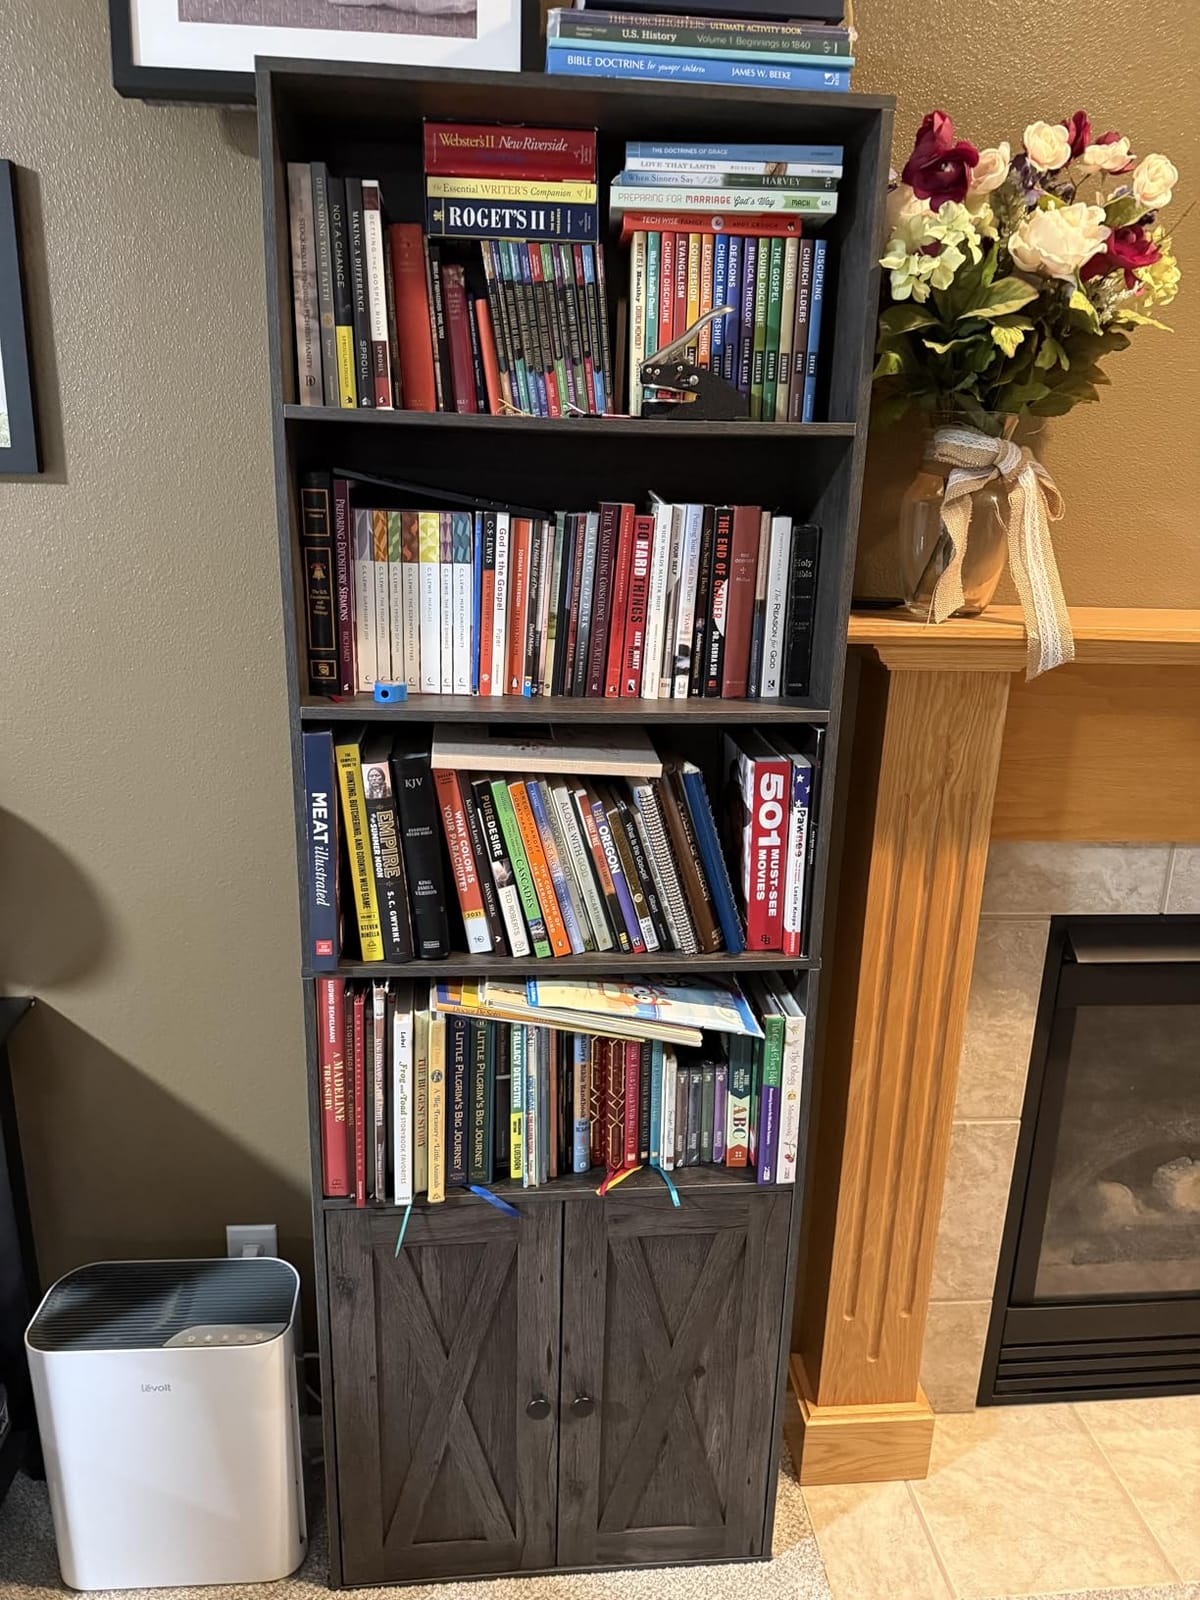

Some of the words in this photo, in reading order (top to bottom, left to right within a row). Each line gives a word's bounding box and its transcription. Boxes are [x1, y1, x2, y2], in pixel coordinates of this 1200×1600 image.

[622, 29, 639, 39] U.S.
[642, 30, 677, 42] History
[697, 35, 727, 45] Volume
[736, 37, 780, 50] Beginnings
[791, 40, 811, 50] 1840
[710, 22, 746, 32] ULTIMATE
[748, 24, 780, 34] ACTIVITY
[567, 55, 592, 67] BIBLE
[595, 57, 645, 71] DOCTRINE
[731, 67, 755, 78] JAMES
[769, 71, 792, 81] BEEKE
[439, 132, 485, 148] Webster's
[499, 136, 523, 149] New
[523, 137, 568, 152] Riverside
[443, 183, 479, 194] Essential
[479, 184, 529, 196] WRITER'S
[530, 187, 572, 199] Companion
[652, 175, 679, 184] Sinners
[762, 176, 801, 187] HARVEY
[332, 203, 341, 228] NOT
[618, 193, 664, 203] PREPARING
[685, 195, 732, 206] MARRIAGE
[733, 195, 756, 208] God's
[791, 199, 811, 207] MACK
[351, 210, 361, 246] MAKING
[368, 213, 378, 252] GETTING
[448, 206, 527, 230] ROGET'S
[319, 240, 329, 267] YOUR
[335, 240, 346, 289] CHANCE
[663, 241, 672, 275] CHURCH
[677, 240, 687, 298] EVANGELISM
[716, 243, 726, 282] CHURCH
[728, 244, 737, 288] DEACONS
[747, 246, 756, 284] BIBLICAL
[759, 247, 768, 279] SOUND
[773, 247, 781, 265] THE
[786, 246, 796, 291] MISSIONS
[801, 247, 811, 285] CHURCH
[354, 258, 365, 313] DIFFERENCE
[371, 272, 380, 304] GOSPEL
[689, 242, 699, 301] CONVERSION
[702, 244, 711, 305] EXPOSITIONAL
[771, 267, 780, 303] GOSPEL
[814, 249, 825, 300] DISCIPLING
[662, 278, 672, 323] DISCIPLINE
[744, 286, 753, 328] THEOLOGY
[757, 282, 766, 327] DOCTRINE
[798, 289, 808, 323] ELDERS
[359, 340, 369, 380] SPROUL
[376, 344, 384, 373] SPROUL
[808, 354, 816, 374] DEVER
[335, 498, 346, 539] PREPARING
[604, 511, 614, 526] THE
[717, 516, 730, 534] THE
[485, 537, 493, 564] LEWIS
[498, 528, 507, 548] God
[585, 526, 596, 573] WALKING
[600, 528, 613, 574] VANISHING
[671, 542, 679, 559] YOUR
[716, 537, 728, 559] END
[337, 541, 348, 585] EXPOSITORY
[497, 561, 505, 577] the
[634, 540, 649, 577] HARD
[714, 562, 726, 577] OF
[495, 578, 505, 611] Gospel
[657, 568, 665, 594] MATTER
[700, 577, 708, 595] Body
[339, 586, 349, 621] SERMONS
[581, 603, 590, 629] DARK
[597, 577, 609, 622] CONSCIENCE
[631, 576, 646, 623] THINGS
[711, 580, 726, 620] GENDER
[770, 603, 782, 638] REASON
[342, 630, 351, 662] RICHARD
[495, 628, 503, 647] Piper
[695, 631, 703, 652] Andrew
[710, 643, 719, 663] DEBRA
[768, 650, 778, 669] GOD
[404, 777, 424, 789] KJV
[310, 792, 329, 844] MEAT
[443, 804, 455, 832] YOUR
[453, 810, 466, 836] WHAT
[513, 792, 528, 832] JONATHAN
[524, 833, 535, 855] HAIDT
[757, 772, 784, 847] 501
[345, 770, 357, 799] HUNTING,
[355, 851, 367, 877] COOKING
[361, 892, 371, 909] GAME
[369, 823, 381, 855] SUMMER
[376, 809, 401, 879] EMPIRE
[525, 813, 541, 854] LUKIANOFF
[550, 816, 563, 847] GARDEN
[564, 865, 573, 883] CITY
[560, 801, 576, 831] ALONE
[569, 832, 582, 858] WITH
[577, 858, 590, 878] GOD
[599, 825, 621, 875] OREGON
[794, 809, 807, 858] Pawnee
[374, 856, 384, 878] MOON
[448, 834, 468, 893] PARACHUTE?
[458, 836, 473, 873] COLOR
[314, 844, 330, 906] illustrated
[515, 858, 534, 909] CASCADES
[539, 863, 549, 879] THE
[544, 880, 558, 917] CODDLING
[694, 859, 710, 901] OREGON
[756, 848, 767, 901] MOVIES
[768, 848, 781, 917] MUST-SEE
[483, 882, 493, 904] DANNY
[536, 878, 551, 915] AMERICAN
[547, 916, 557, 934] MIND
[648, 894, 659, 913] Gilbert
[792, 886, 800, 906] Leslie
[389, 910, 401, 943] GWYNNE
[487, 903, 496, 918] SILK
[507, 904, 520, 937] ROBERTS
[790, 907, 799, 927] Knope
[327, 980, 336, 1004] LUDWIG
[328, 1005, 337, 1043] BEMELMANS
[454, 1031, 465, 1062] LITTLE
[476, 1030, 486, 1060] LITTLE
[512, 1030, 523, 1065] FALLACY
[399, 1060, 408, 1084] Frog
[417, 1058, 427, 1078] THE
[786, 1064, 799, 1087] Ology
[323, 1063, 333, 1110] TREASURY
[333, 1060, 345, 1122] MADELINE
[416, 1078, 426, 1117] BIGGEST
[454, 1063, 465, 1110] PILGRIM'S
[475, 1062, 485, 1109] PILGRIM'S
[512, 1066, 522, 1109] DETECTIVE
[399, 1094, 408, 1116] Toad
[454, 1111, 463, 1128] BIG
[475, 1109, 484, 1126] BIG
[733, 1103, 748, 1140] ABC
[399, 1116, 407, 1153] STORYBOOK
[416, 1118, 426, 1149] STORY
[432, 1109, 441, 1138] Treasury
[433, 1142, 441, 1162] Little
[453, 1129, 463, 1169] JOURNEY
[474, 1127, 484, 1169] JOURNEY
[513, 1143, 521, 1171] BLUEDORN
[399, 1153, 407, 1184] FAVORITES
[433, 1162, 441, 1189] Animals
